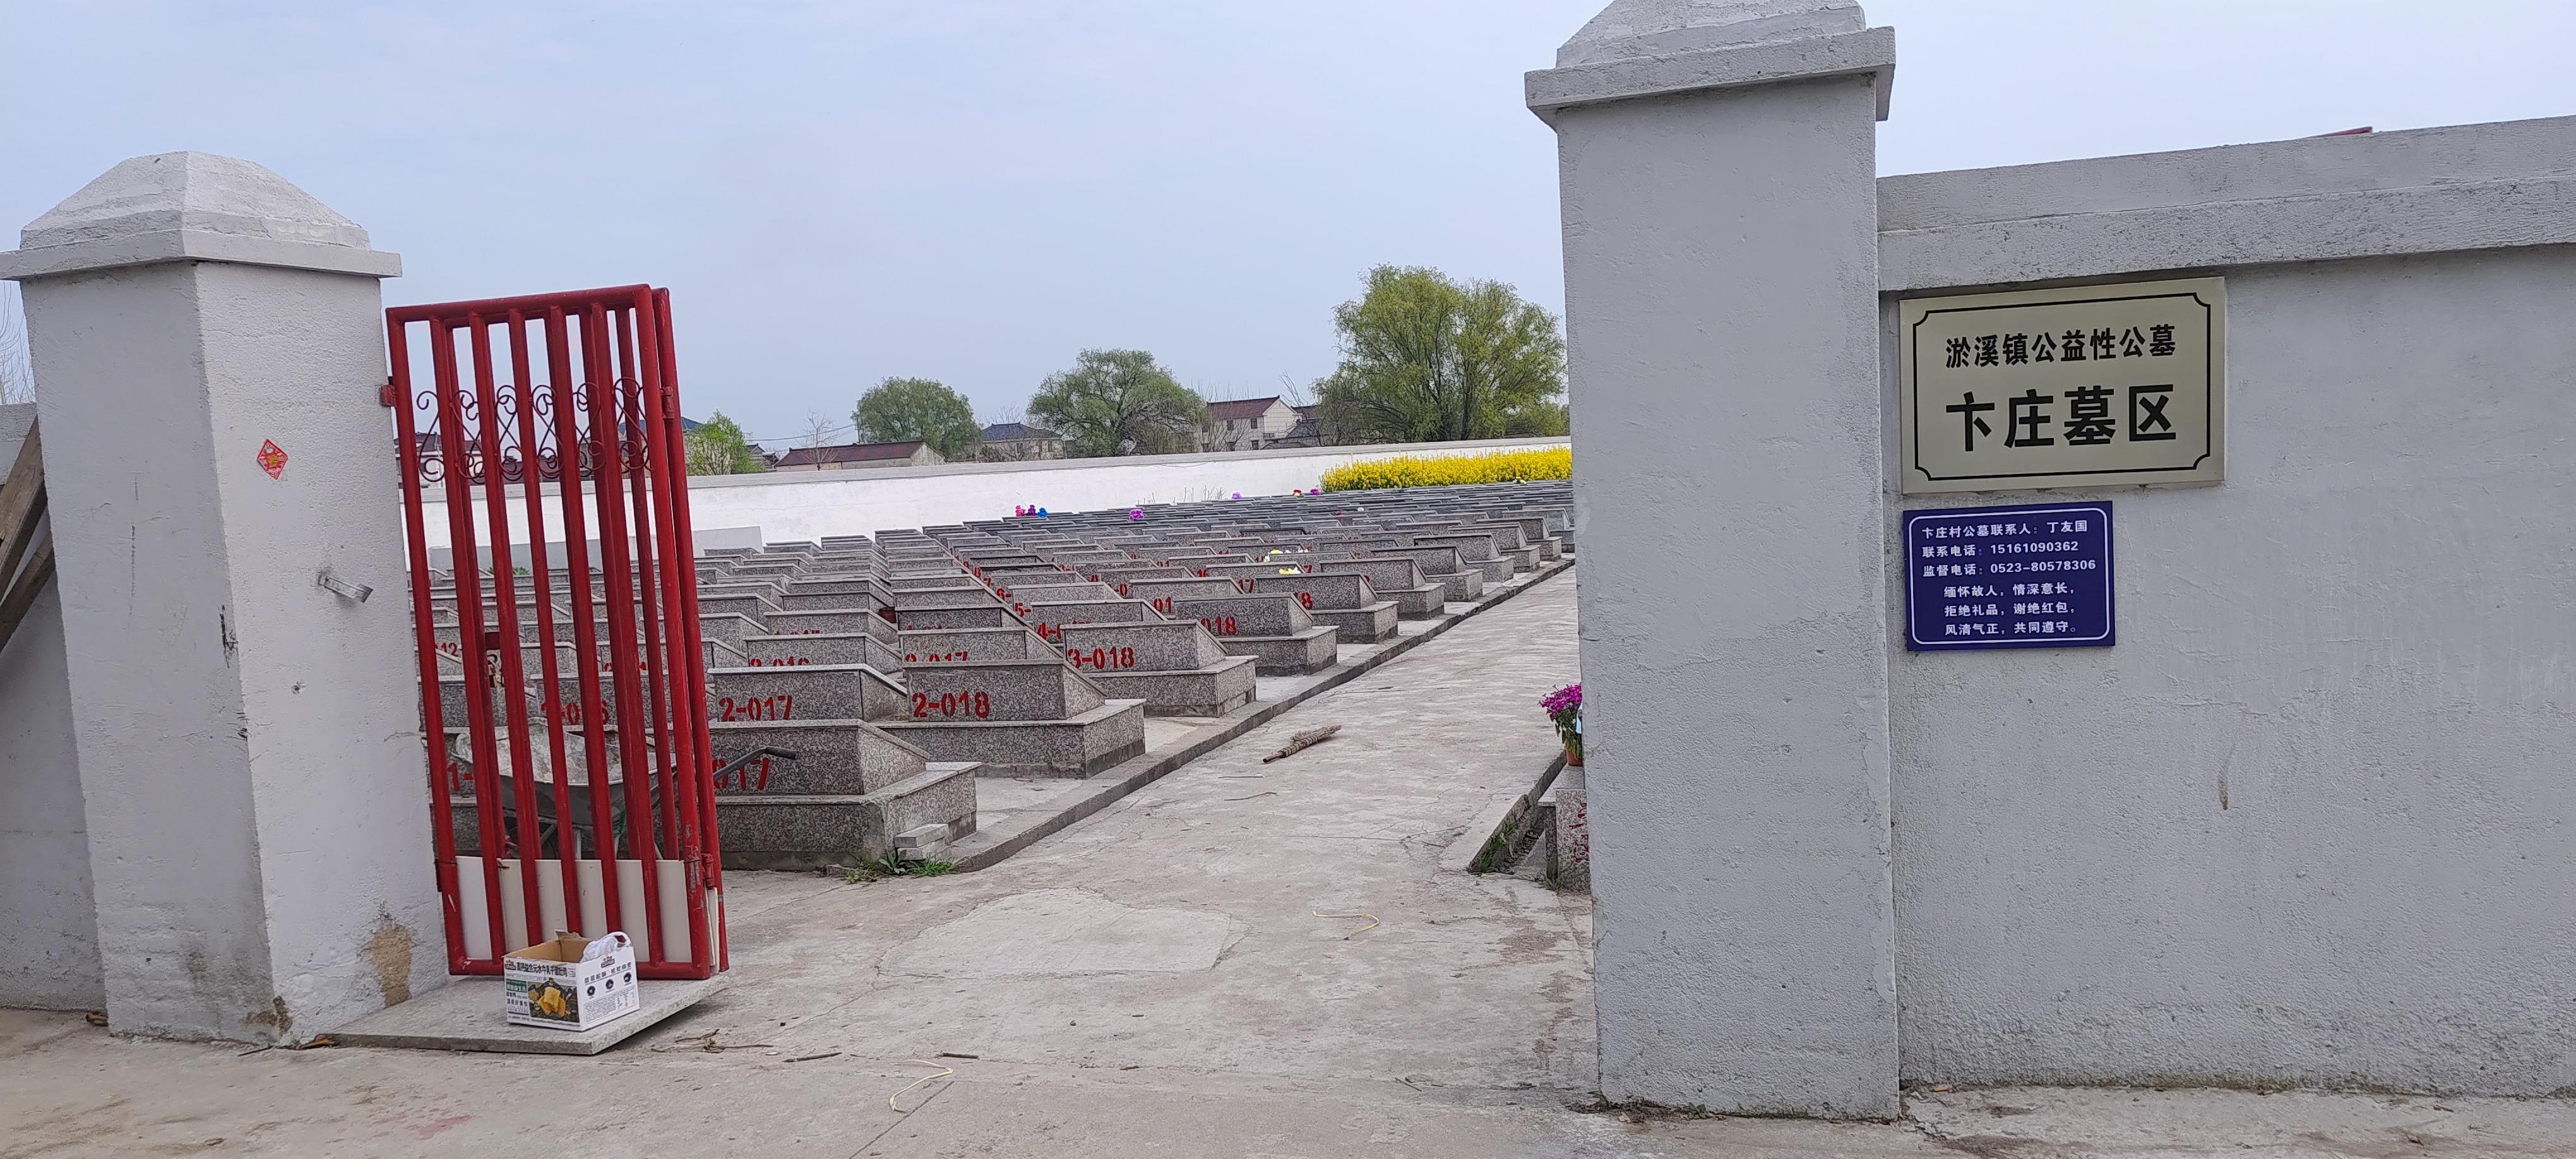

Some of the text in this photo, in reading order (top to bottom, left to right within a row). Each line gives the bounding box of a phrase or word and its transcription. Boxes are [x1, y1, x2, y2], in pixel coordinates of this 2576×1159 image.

[1945, 324, 2176, 369] 淤溪镇公益性公墓
[1946, 384, 2176, 451] 卞庄墓区
[1068, 646, 1135, 670] 3-018
[719, 695, 792, 722] 2-017
[912, 690, 990, 718] 2-018
